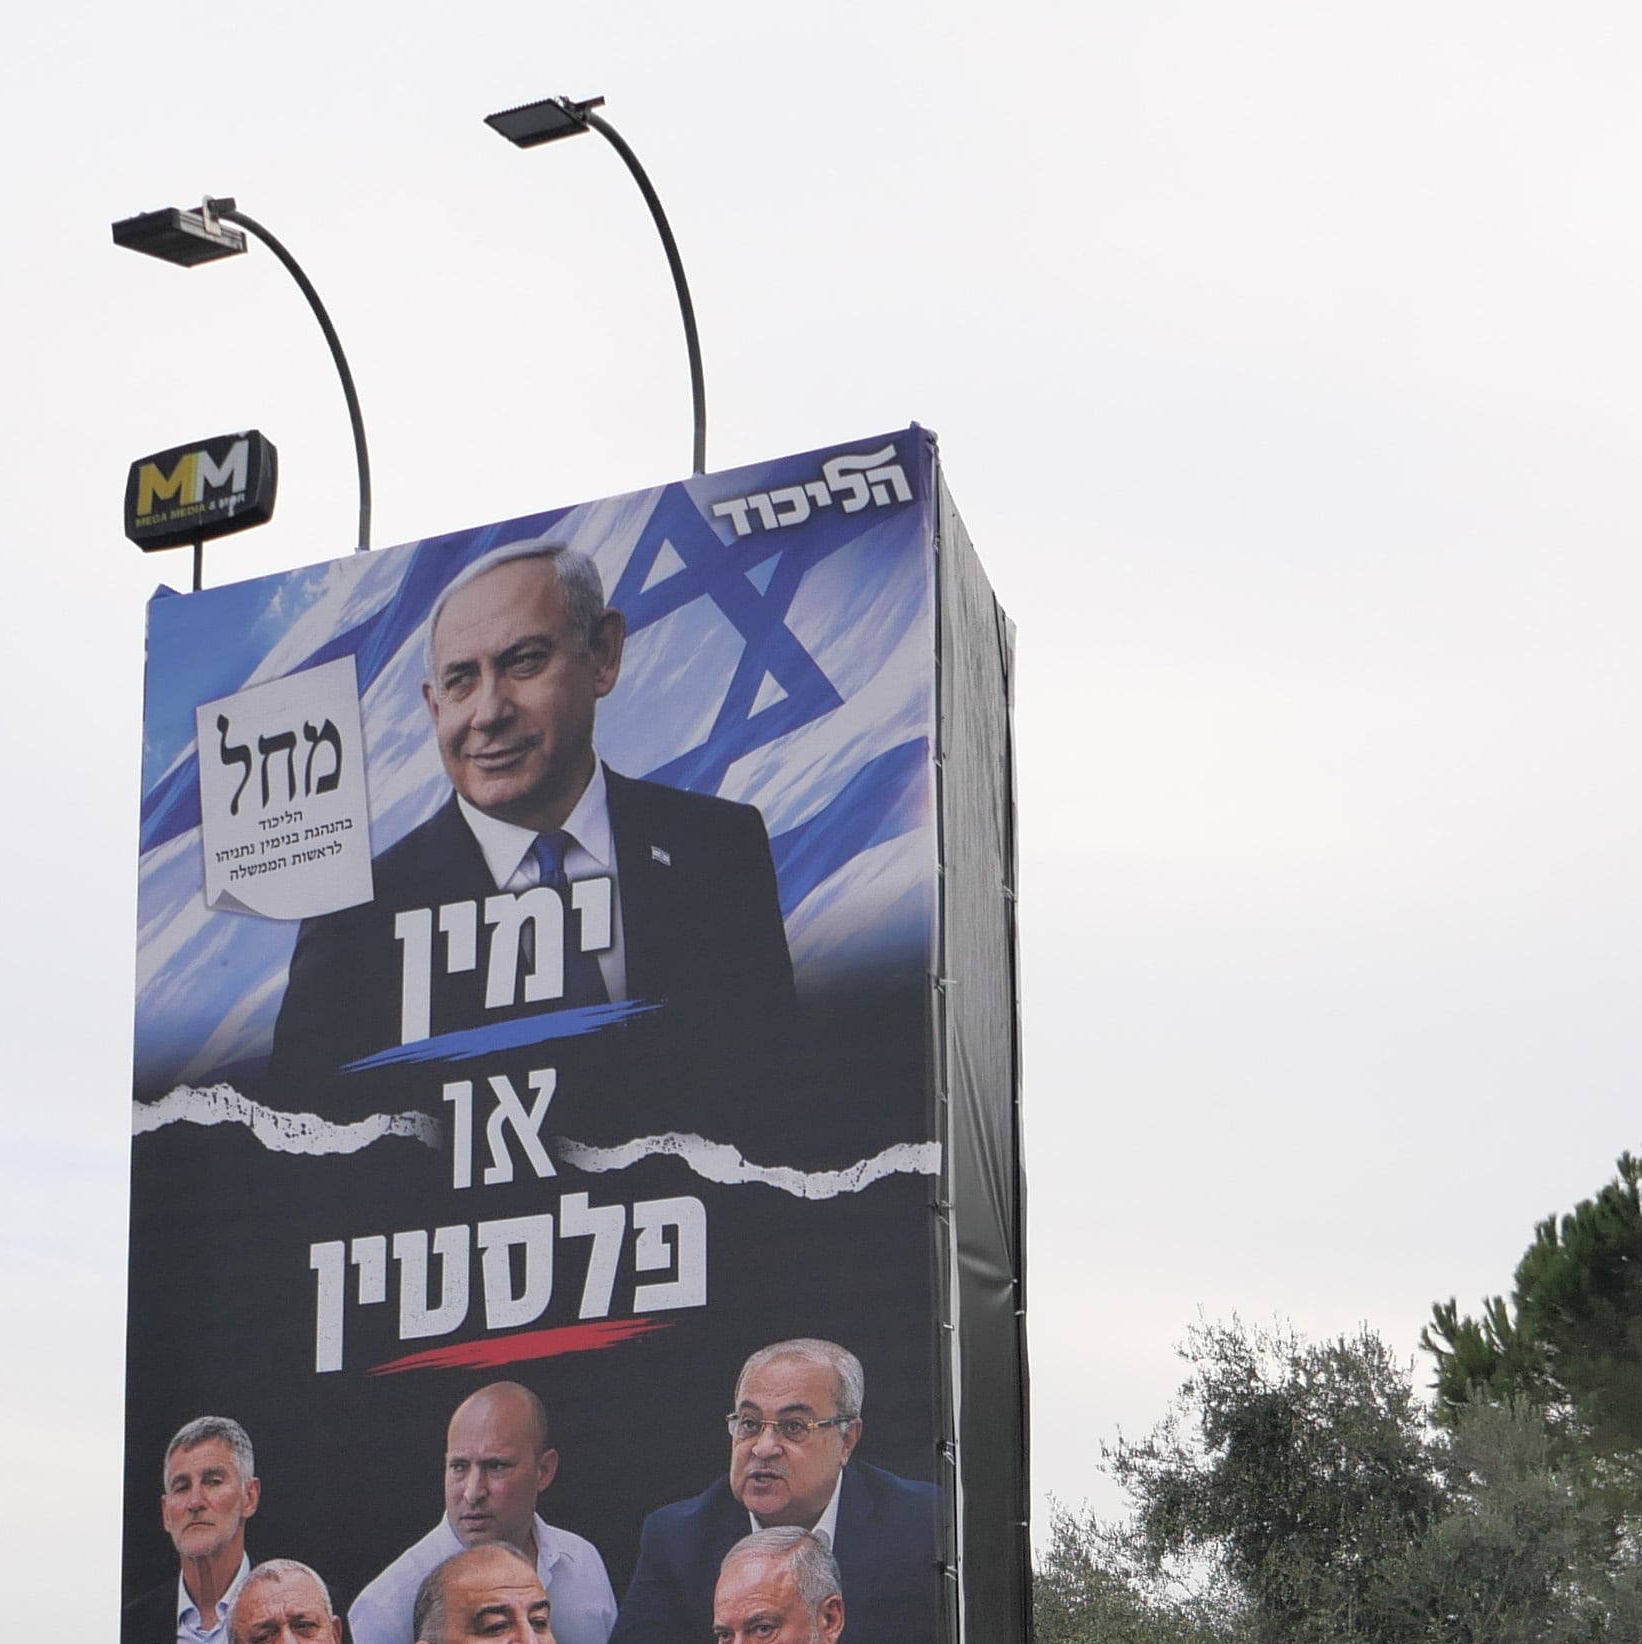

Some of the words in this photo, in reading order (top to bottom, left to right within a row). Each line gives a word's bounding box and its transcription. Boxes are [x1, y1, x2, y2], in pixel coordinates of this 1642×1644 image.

[137, 440, 249, 516] MM
[712, 444, 913, 536] הליכוד
[135, 512, 168, 528] MEGA
[170, 504, 206, 520] MEDIA
[208, 500, 217, 511] &
[217, 714, 343, 816] מחל
[258, 810, 303, 831] הליכוד
[304, 817, 353, 841] בהנהגת
[215, 843, 255, 864] נתניהו
[260, 831, 300, 854] בנימין
[291, 840, 343, 866] לראשות
[229, 857, 287, 881] הממשלה
[394, 877, 612, 1046] ימין
[443, 1067, 557, 1189] או
[310, 1192, 707, 1373] פלסטין
